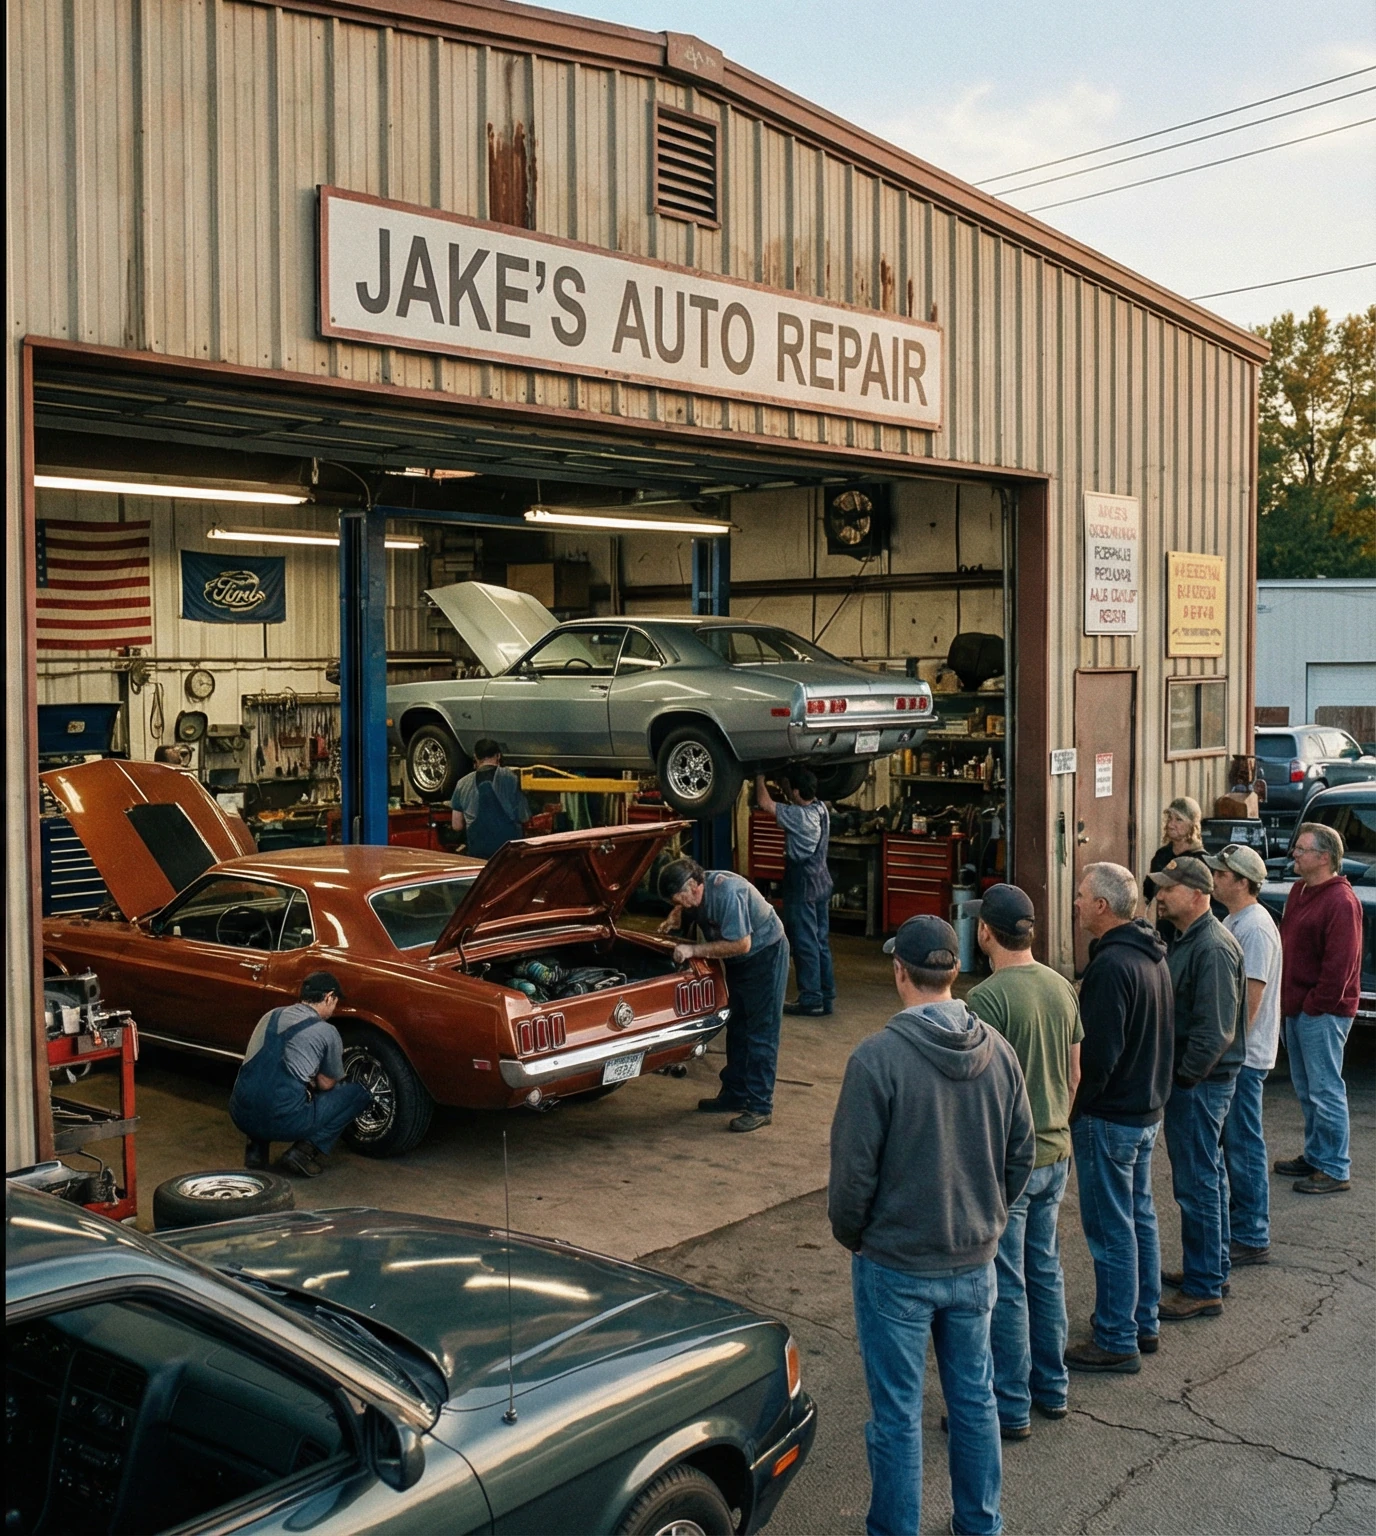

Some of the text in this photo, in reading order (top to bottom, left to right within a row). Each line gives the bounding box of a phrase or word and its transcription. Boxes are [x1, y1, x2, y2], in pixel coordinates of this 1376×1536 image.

[356, 228, 928, 406] JAKE'S AUTO REPAIR
